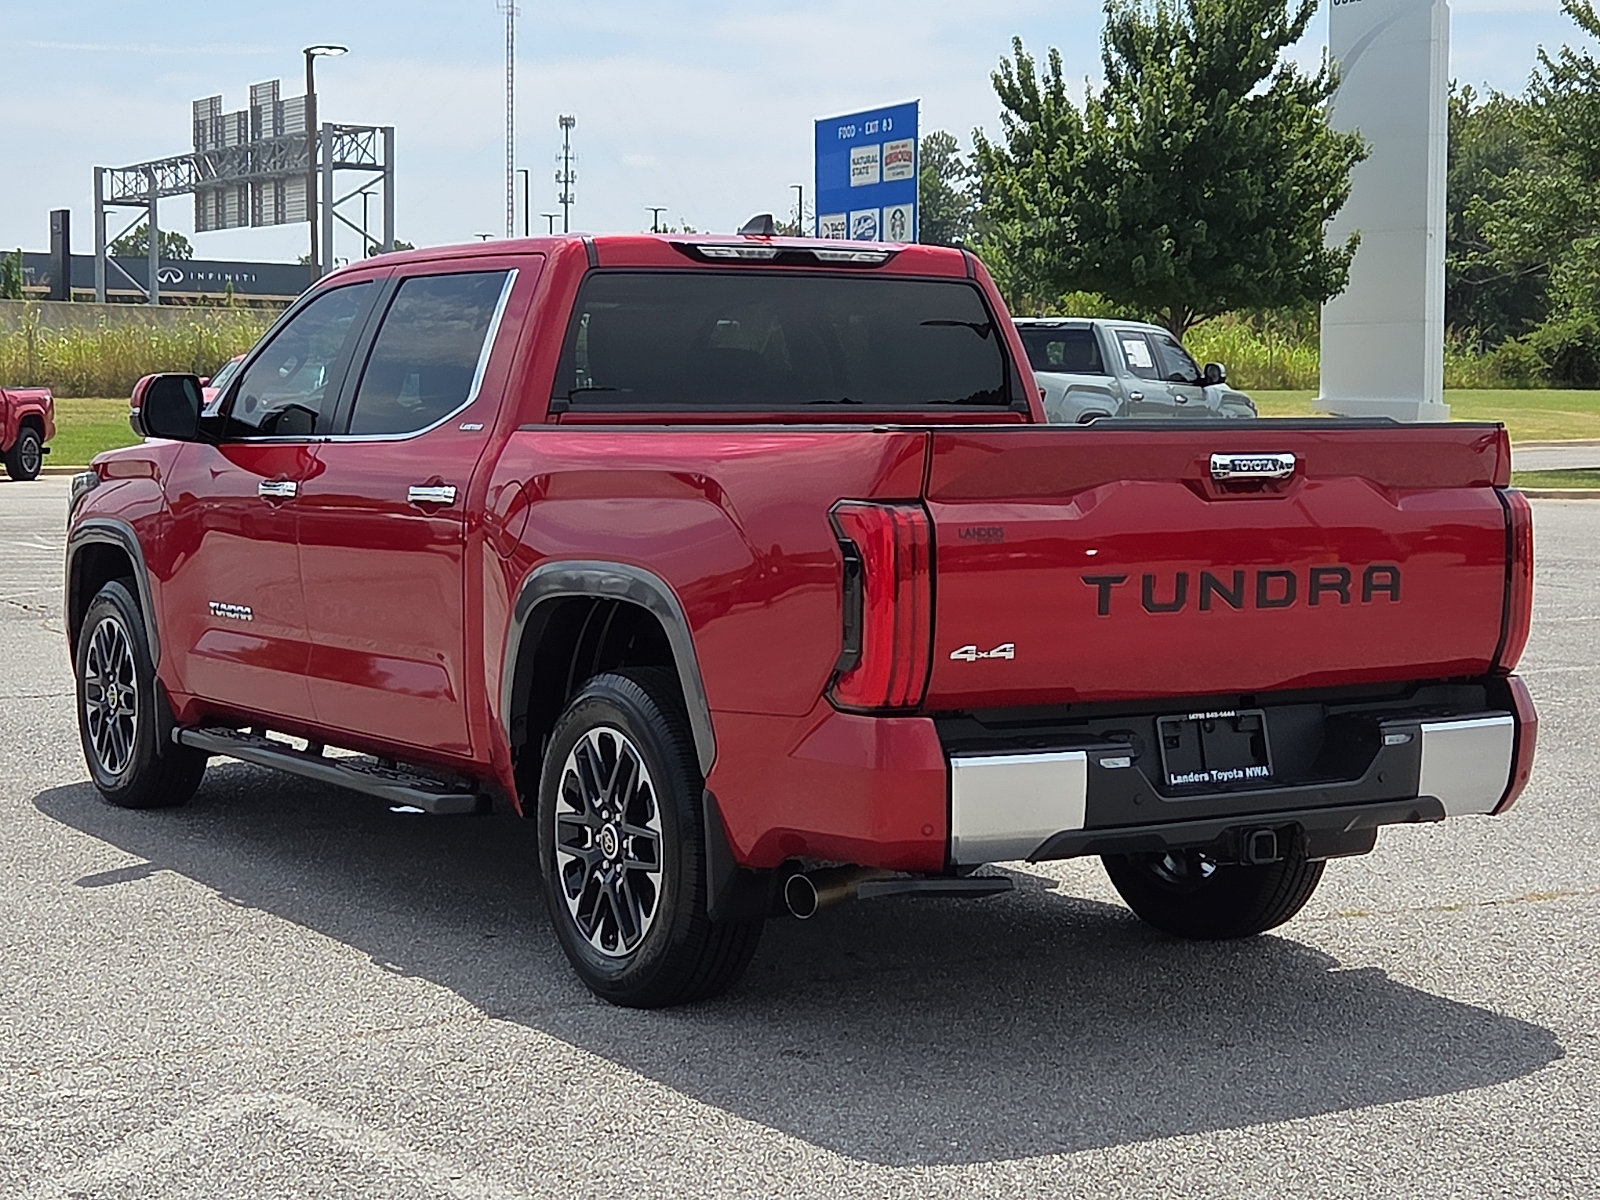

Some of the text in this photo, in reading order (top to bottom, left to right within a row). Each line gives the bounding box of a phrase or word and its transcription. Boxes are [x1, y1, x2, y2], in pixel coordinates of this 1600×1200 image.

[838, 125, 856, 139] FOOD
[865, 120, 879, 135] EXIT
[882, 118, 893, 132] 83
[852, 154, 878, 166] NATURAL
[852, 166, 870, 177] STATE
[830, 221, 846, 232] TACO
[189, 271, 257, 282] INFINITI
[1234, 460, 1275, 471] TOYOTA
[1080, 565, 1401, 617] TUNDRA
[208, 601, 253, 621] TUNDRA
[1170, 765, 1270, 785] Landers Toyota NWA
